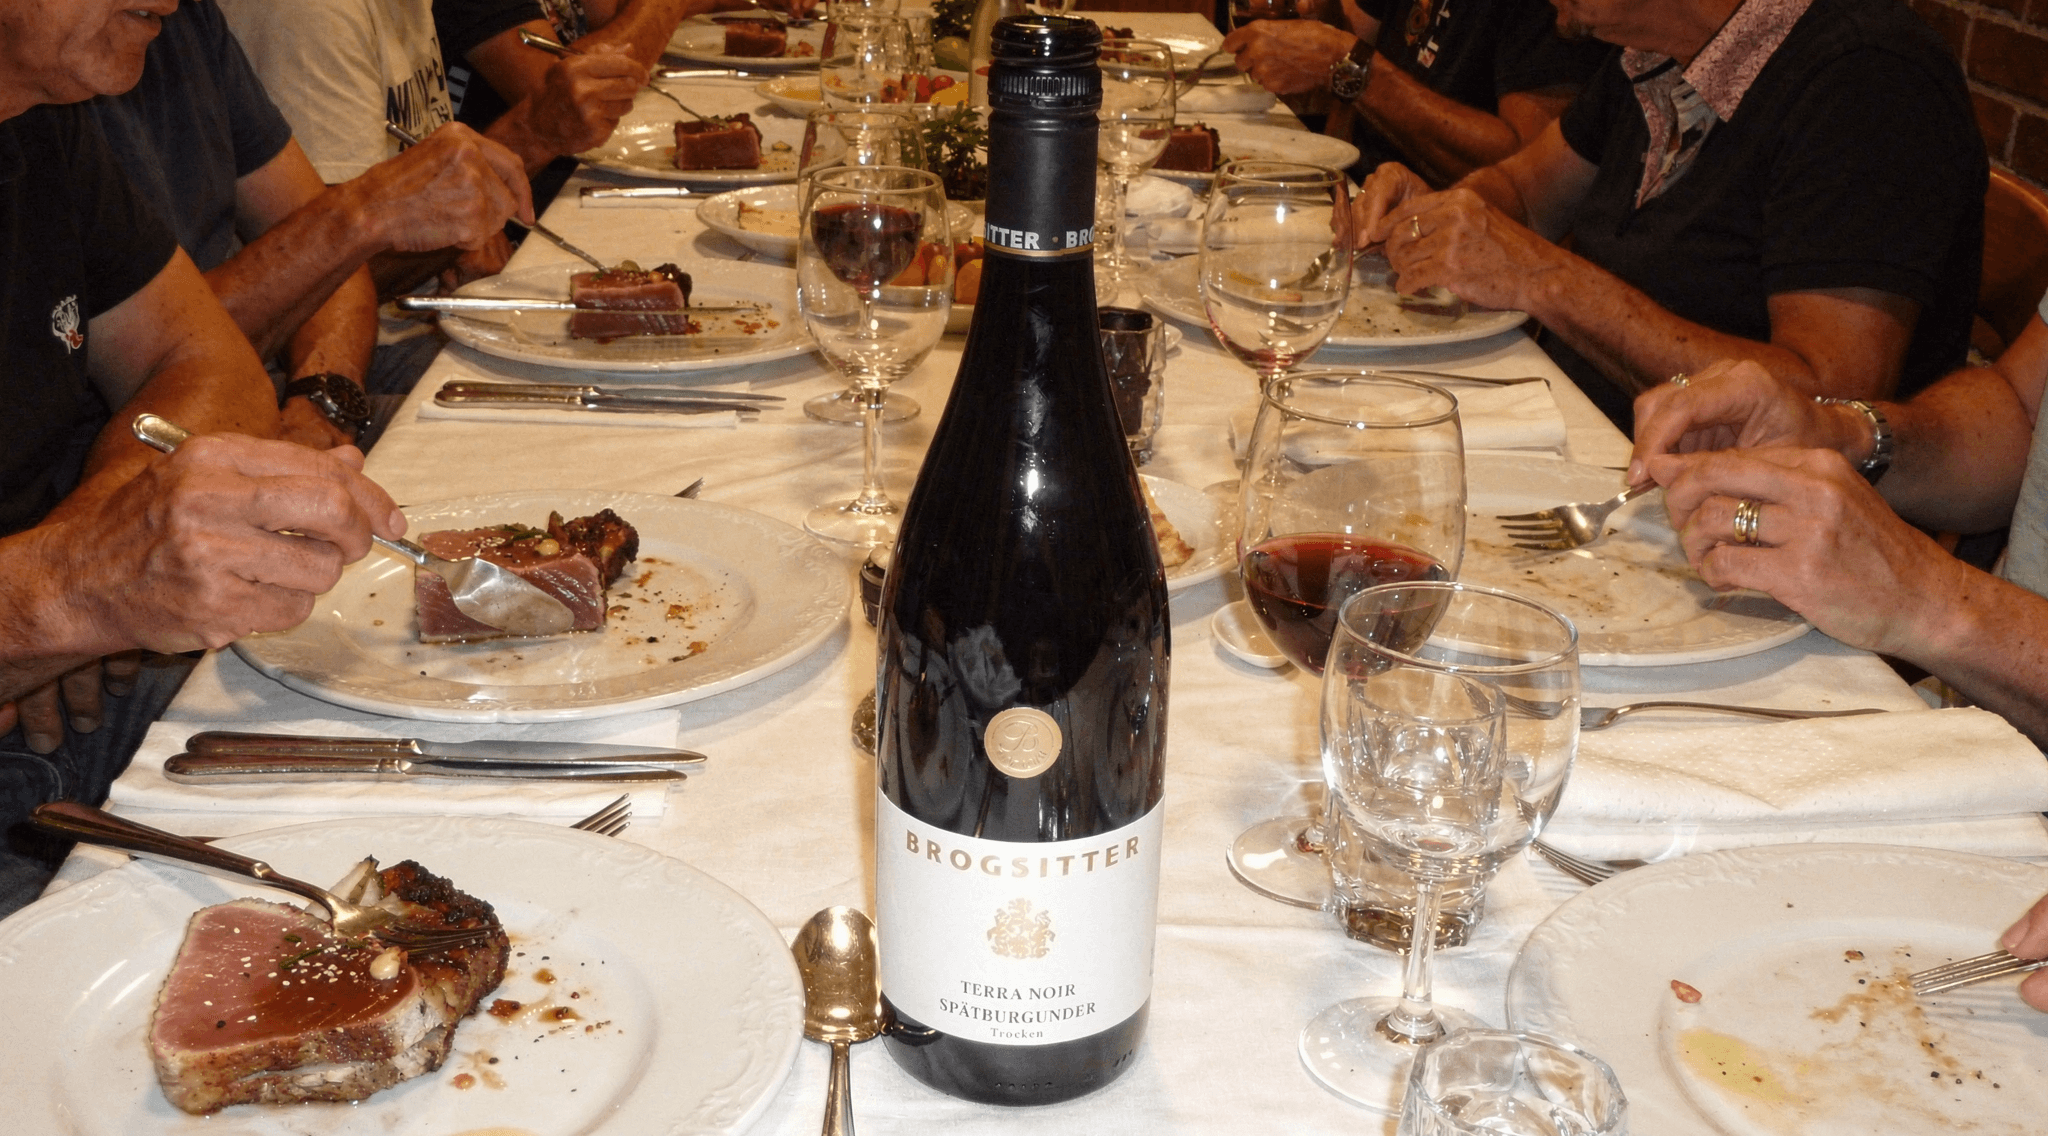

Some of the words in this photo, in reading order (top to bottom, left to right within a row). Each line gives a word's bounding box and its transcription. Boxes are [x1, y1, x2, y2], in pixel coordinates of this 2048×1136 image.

[985, 222, 1040, 250] ITTER
[906, 829, 1139, 878] BROGSITTER
[960, 980, 1022, 1000] TERRA
[1029, 983, 1076, 1000] NOIR
[939, 997, 1096, 1024] SPÄTBURGUNDER
[990, 1027, 1043, 1039] Trocken
